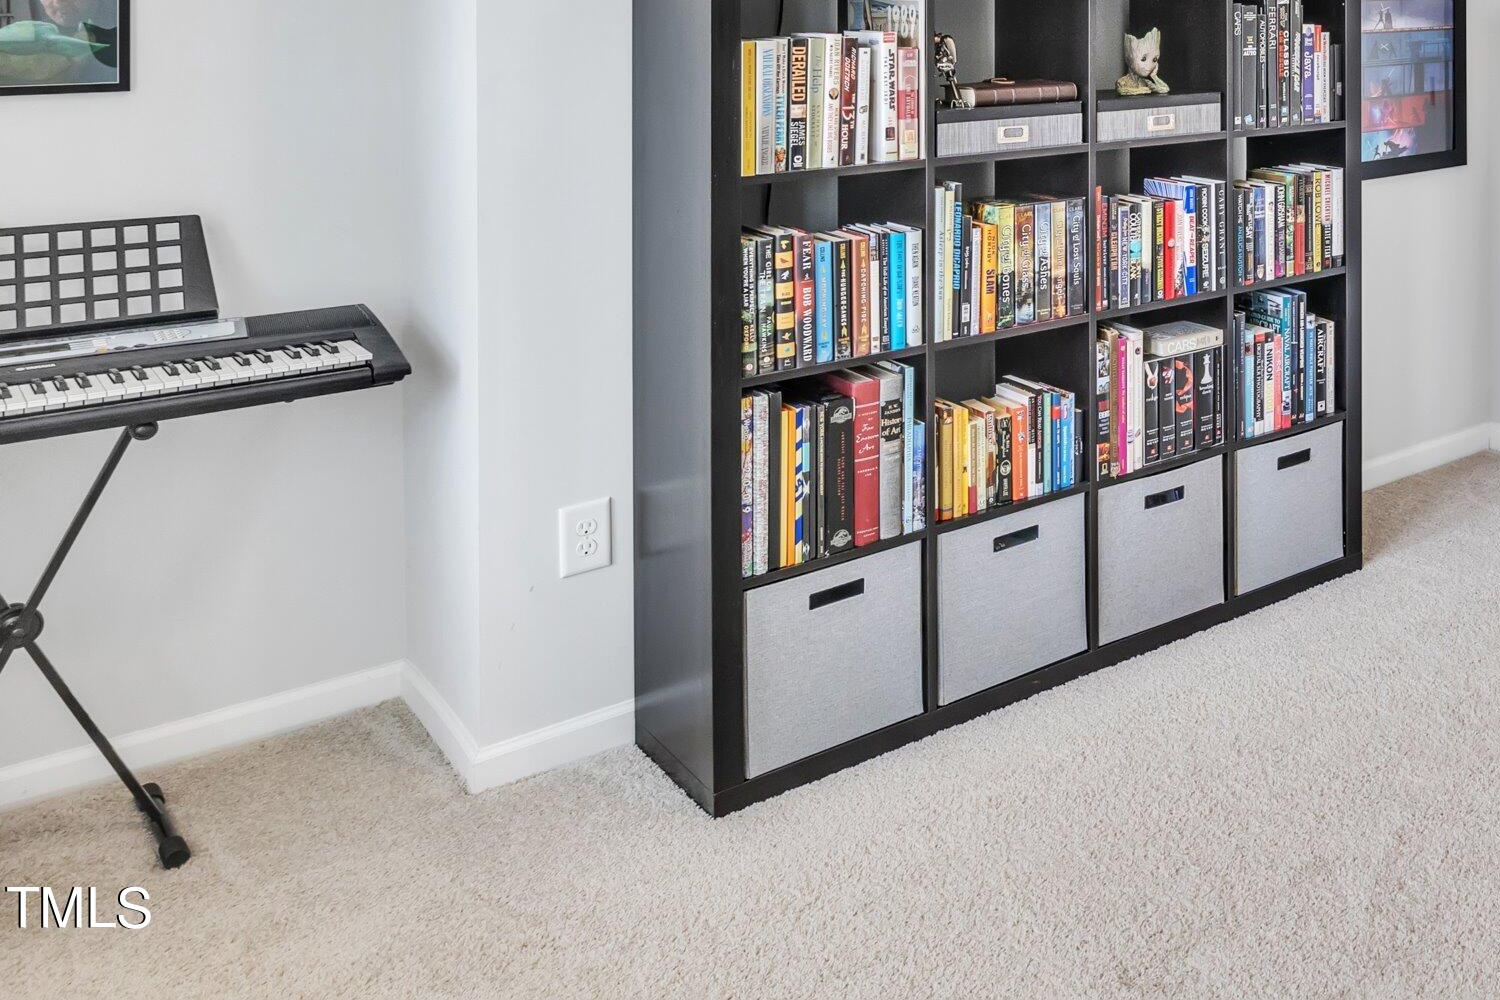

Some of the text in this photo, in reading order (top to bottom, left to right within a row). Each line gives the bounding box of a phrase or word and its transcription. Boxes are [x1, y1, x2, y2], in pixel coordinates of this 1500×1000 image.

[792, 46, 806, 101] DERAILED
[1304, 51, 1313, 78] Java
[811, 68, 822, 93] Help
[775, 95, 785, 146] TYLER PERRY
[790, 122, 798, 148] SIEGEL
[841, 124, 849, 150] HOUR
[1277, 186, 1285, 228] JOHN GRISHAM
[1071, 215, 1080, 233] City
[953, 201, 962, 290] LEONARDO DICAPRIO
[1020, 224, 1031, 288] City Glass
[1038, 222, 1048, 290] City Ashes
[1073, 243, 1082, 261] Lost
[1000, 225, 1012, 303] City Bones
[1073, 263, 1081, 285] Souls
[986, 269, 995, 294] SLAM
[1055, 270, 1064, 299] Angels
[803, 241, 812, 362] FEAR BOB WOODWARD
[1168, 338, 1196, 354] CARS
[882, 428, 890, 436] of
